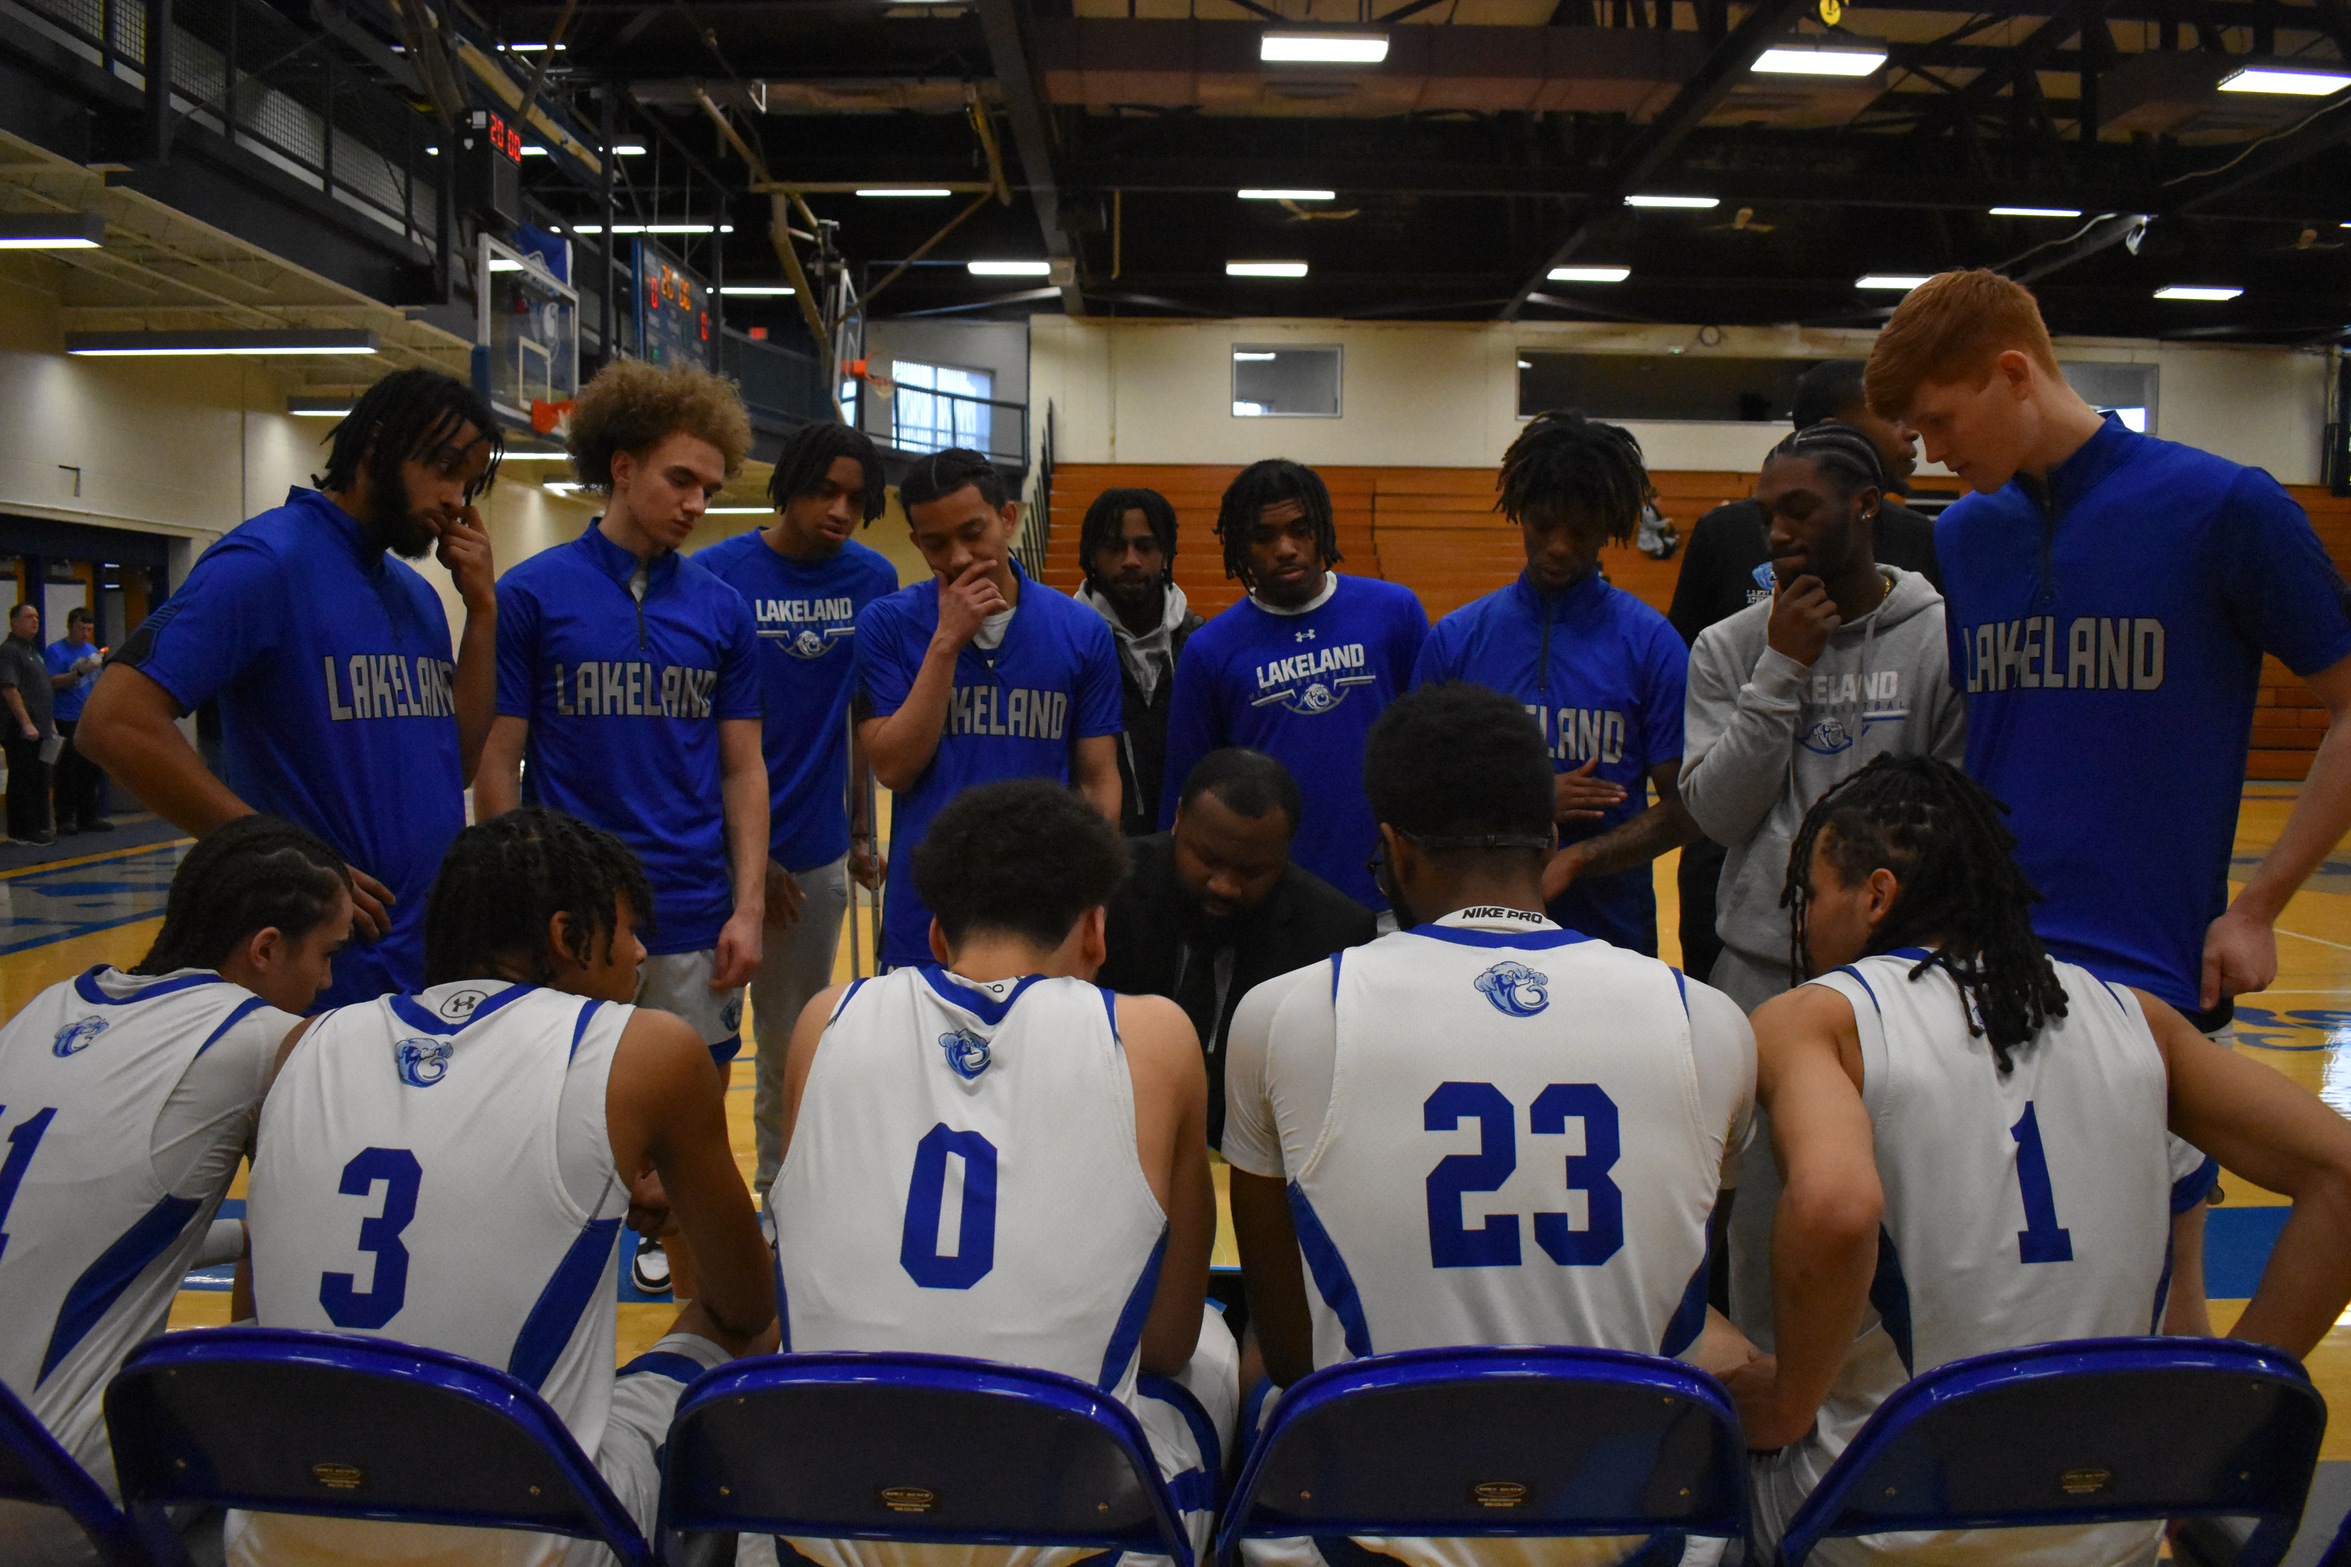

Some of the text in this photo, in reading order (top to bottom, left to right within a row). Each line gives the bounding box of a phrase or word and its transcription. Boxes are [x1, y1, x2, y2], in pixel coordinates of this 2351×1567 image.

[755, 597, 853, 622] LAKELAND
[555, 661, 718, 718] LAKELAND
[1256, 643, 1365, 689] LAKELAND
[1963, 615, 2165, 693] LAKELAND
[943, 685, 1068, 740] KELAND
[1462, 907, 1543, 924] NIKE PRO
[0, 1104, 58, 1264] 1
[899, 1121, 998, 1290] 0
[1423, 1081, 1624, 1268] 23
[2009, 1100, 2074, 1263] 1
[319, 1146, 423, 1330] 3
